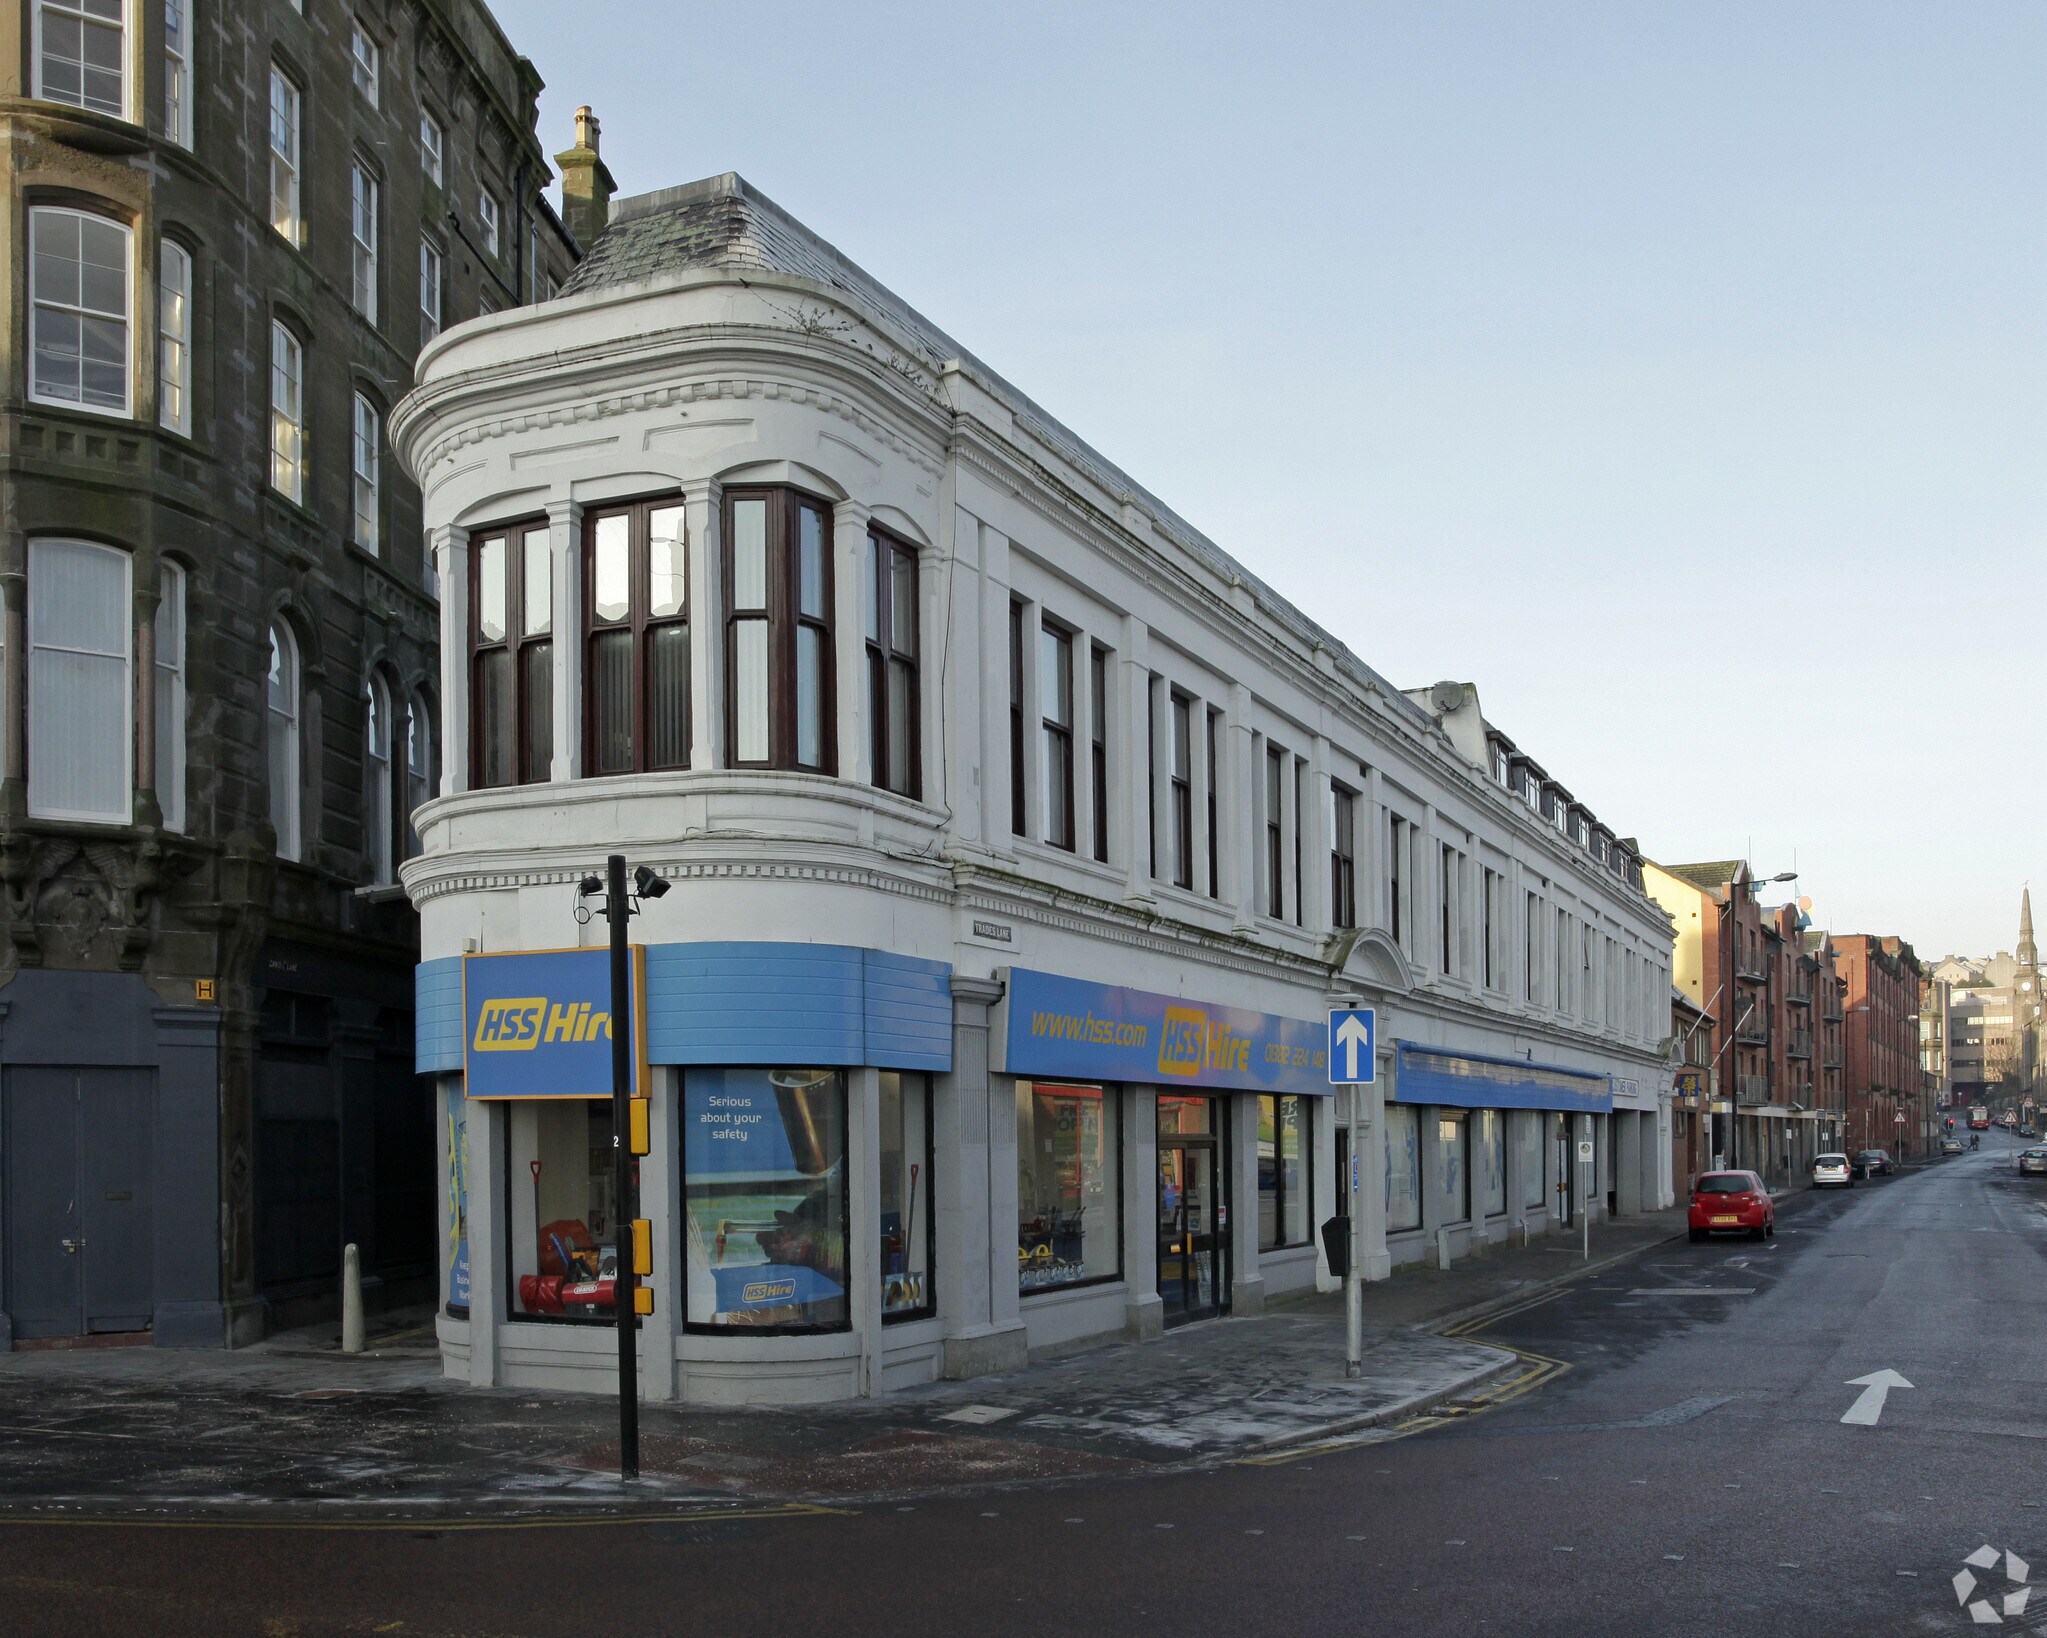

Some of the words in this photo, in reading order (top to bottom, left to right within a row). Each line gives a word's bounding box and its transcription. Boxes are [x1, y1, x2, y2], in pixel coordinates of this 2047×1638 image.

[975, 923, 996, 936] TRADES
[996, 927, 1010, 939] LANE
[198, 981, 212, 998] H
[480, 1006, 540, 1042] HSS
[1031, 1010, 1148, 1048] www.hss.com
[1162, 1017, 1201, 1064] HSS
[1203, 1020, 1251, 1073] Hire
[708, 1095, 752, 1107] Serious
[700, 1112, 732, 1123] about
[734, 1114, 762, 1125] your
[613, 1135, 619, 1147] 2
[712, 1128, 748, 1141] safety
[746, 1287, 766, 1298] HSS
[766, 1284, 793, 1297] Hire
